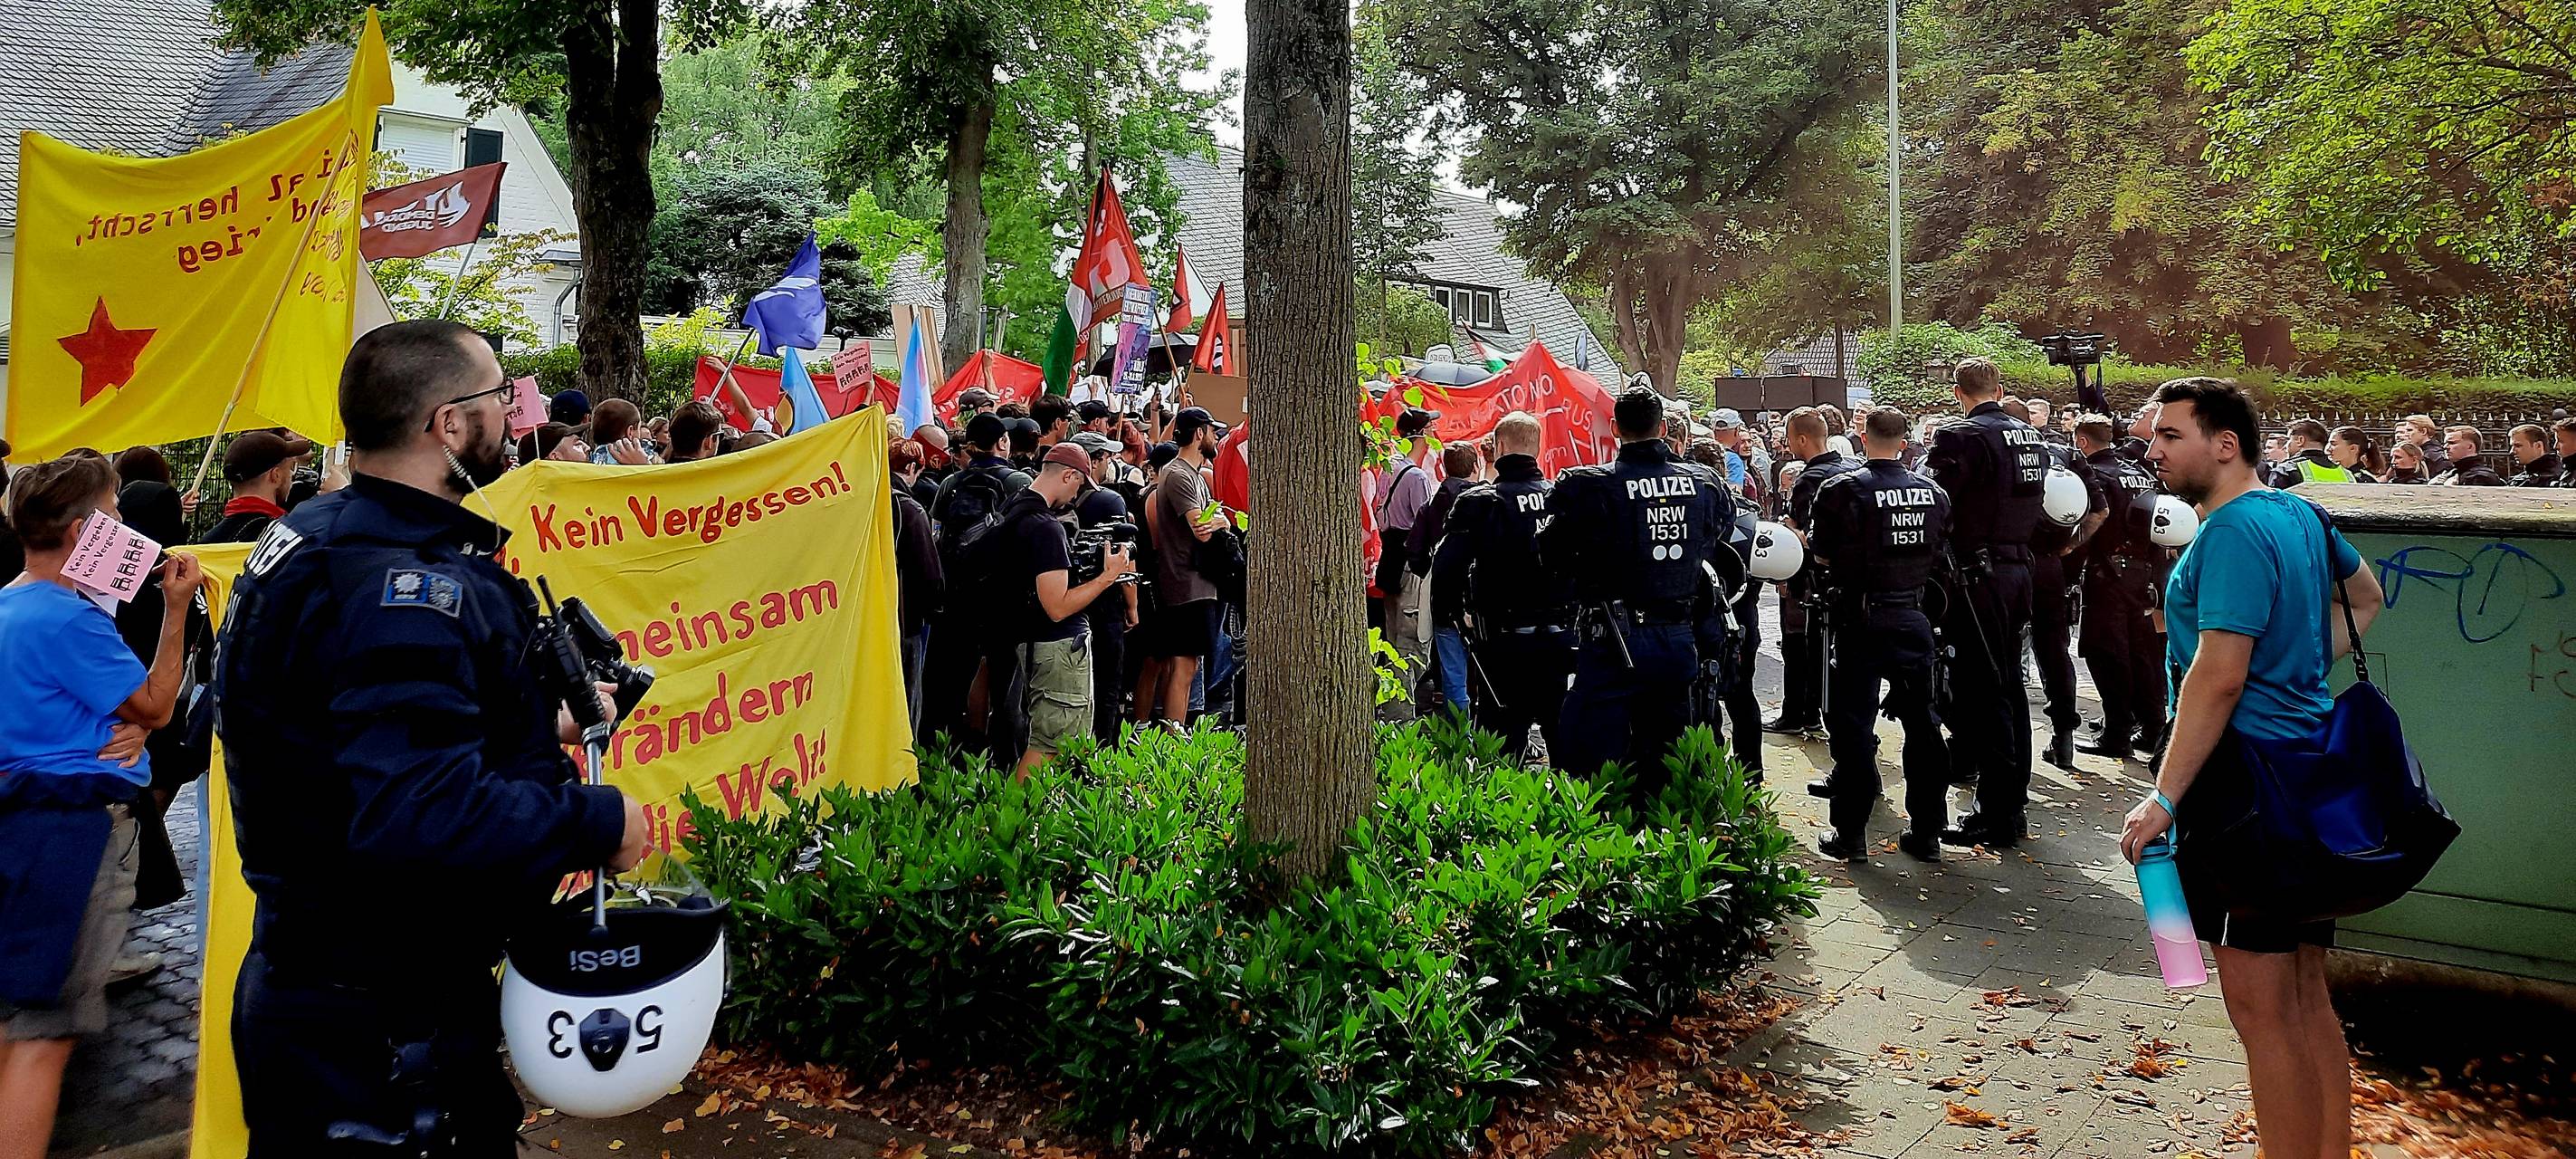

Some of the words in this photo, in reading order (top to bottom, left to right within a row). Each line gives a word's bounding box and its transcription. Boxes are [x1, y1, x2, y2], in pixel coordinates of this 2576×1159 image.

[2018, 453, 2040, 467] NRW
[2021, 468, 2042, 483] 1531
[1626, 475, 1697, 500] POLIZEI
[1875, 487, 1936, 508] POLIZEI
[530, 503, 624, 553] Kein
[627, 461, 853, 545] Vergessen!
[1646, 505, 1686, 523] NRW
[1891, 512, 1925, 527] NRW
[1649, 523, 1688, 541] 1531
[1891, 530, 1925, 545] 1531
[68, 553, 87, 573] Kein
[81, 560, 100, 579] Kein
[615, 580, 839, 663] einsam
[569, 944, 642, 972] BeSi
[548, 1010, 576, 1059] 3
[635, 1003, 665, 1056] 5
